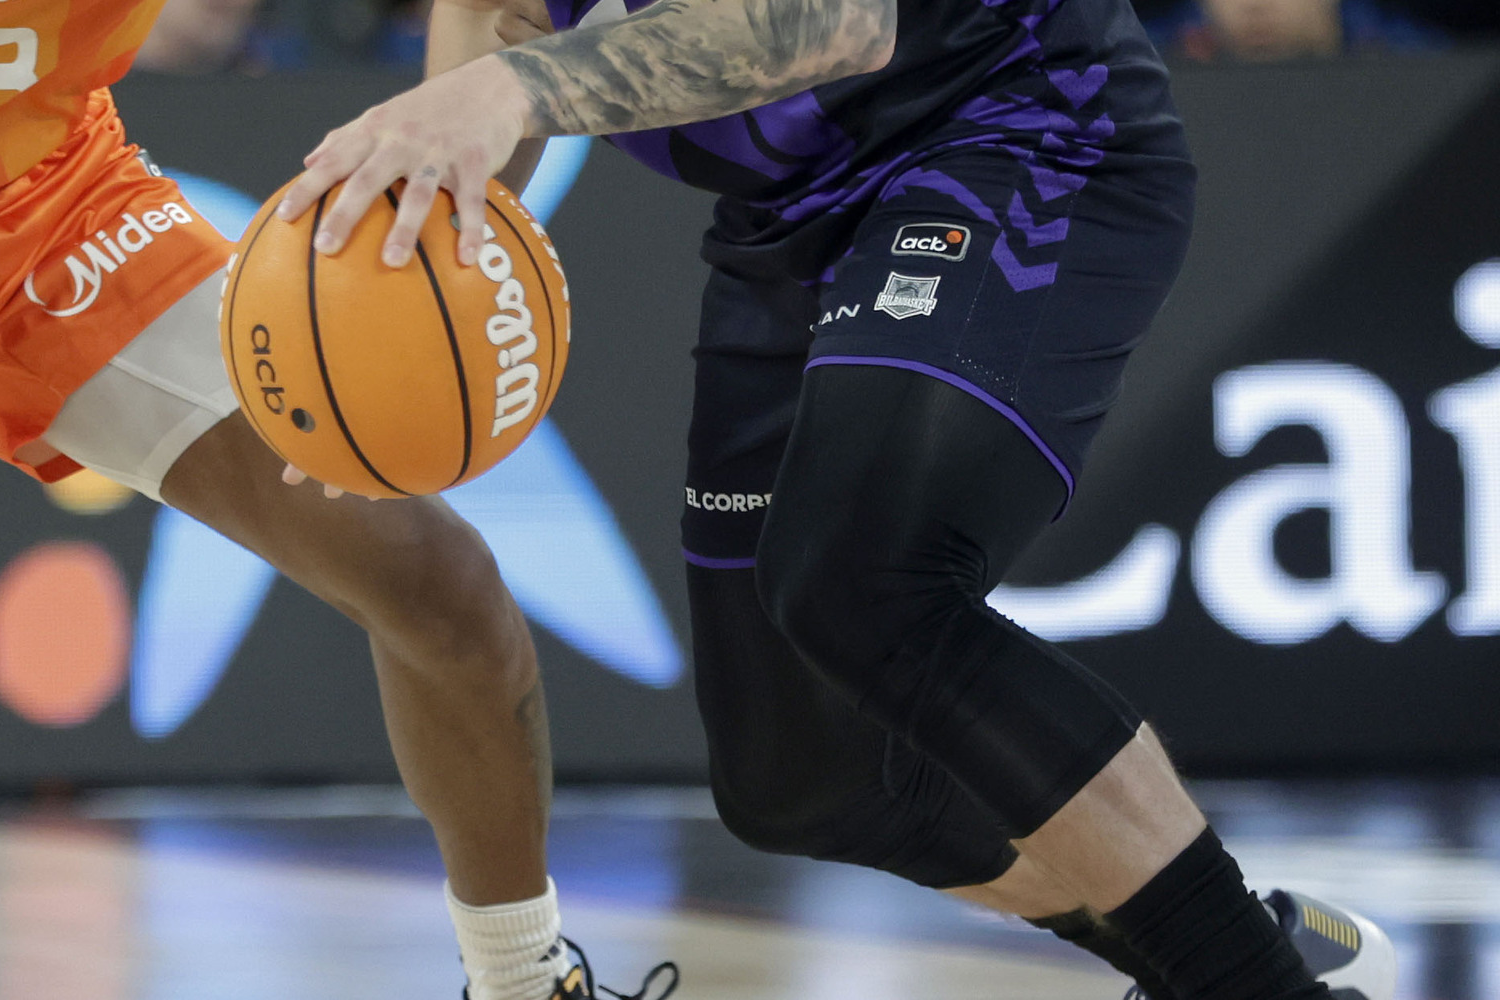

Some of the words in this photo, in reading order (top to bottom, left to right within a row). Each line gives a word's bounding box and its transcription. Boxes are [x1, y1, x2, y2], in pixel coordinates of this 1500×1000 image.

[24, 200, 193, 317] Midea
[900, 235, 948, 252] acb
[251, 323, 286, 416] acb
[685, 486, 702, 509] EL
